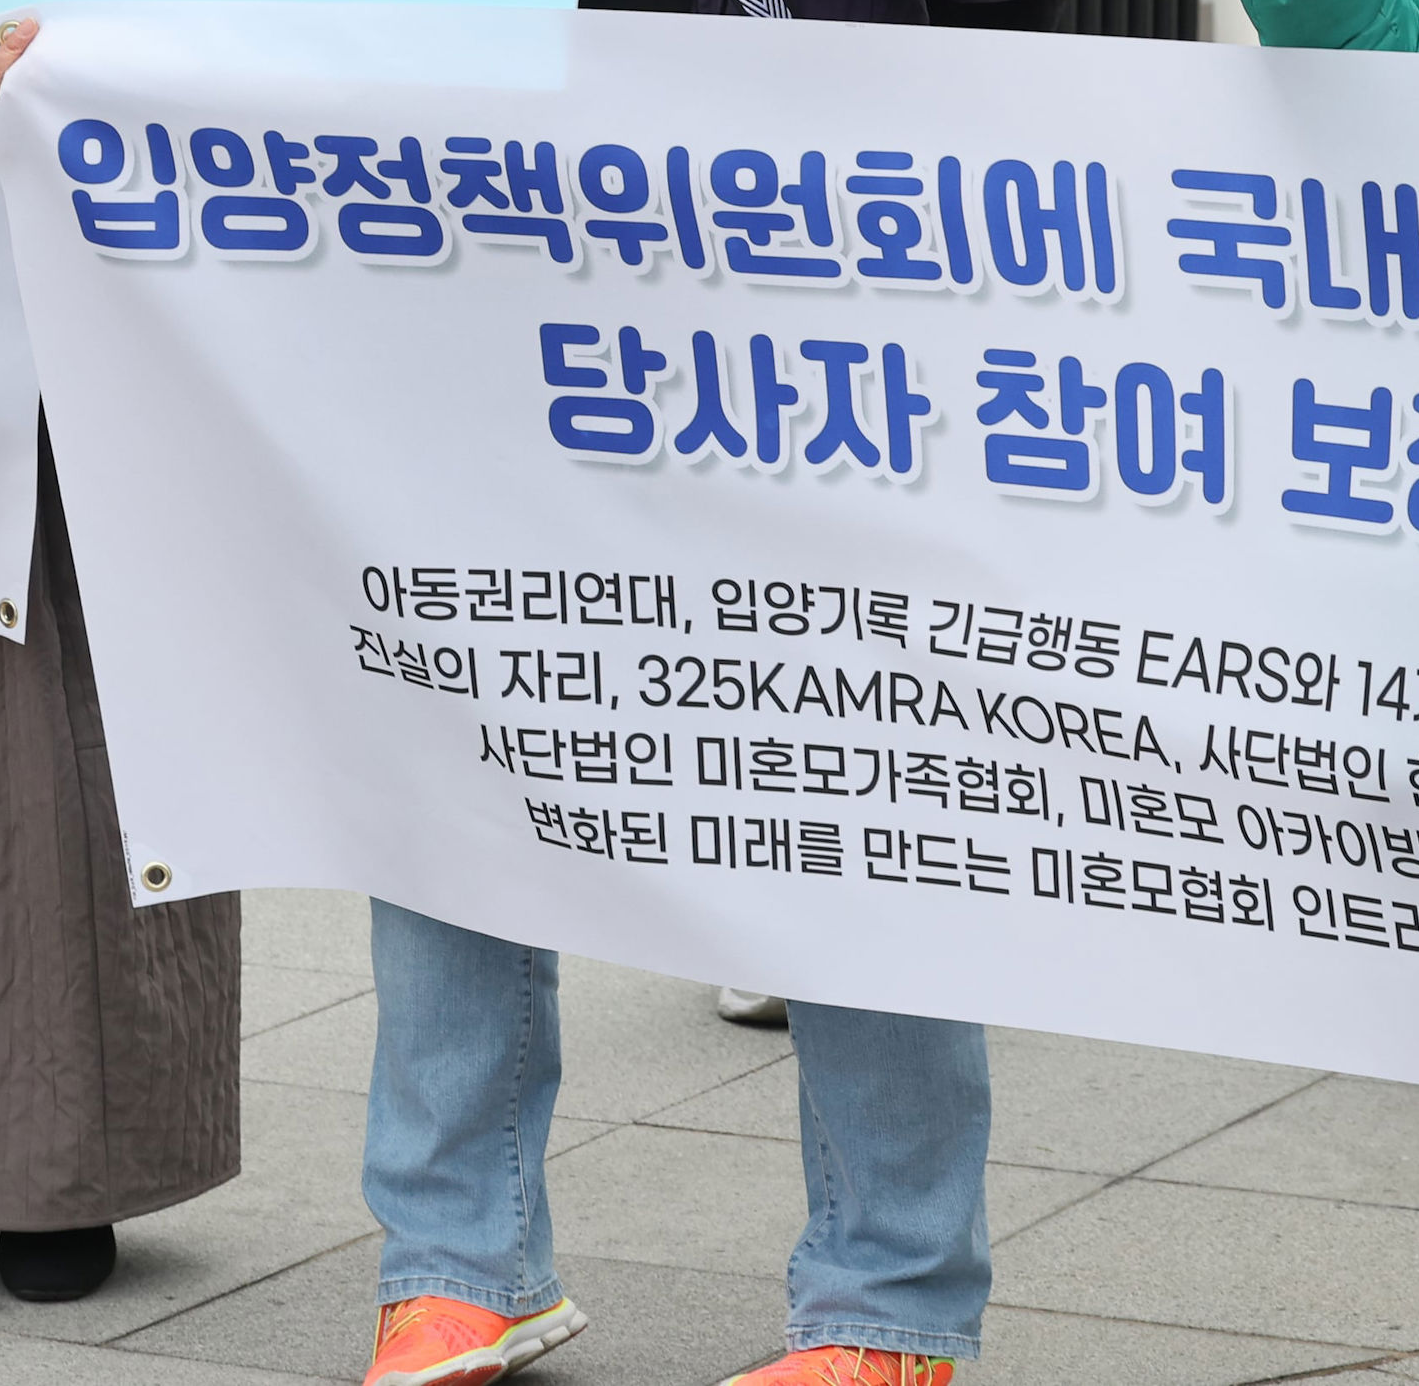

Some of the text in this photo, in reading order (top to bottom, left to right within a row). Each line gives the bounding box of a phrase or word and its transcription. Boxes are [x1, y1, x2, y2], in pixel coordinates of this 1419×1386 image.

[59, 120, 1115, 293] 입양정책위원회에
[541, 324, 930, 473] 당사자
[978, 349, 1224, 504] 참여
[350, 625, 478, 699] 진실의
[500, 650, 618, 710] 자리,
[639, 655, 969, 730] 325KAMRA
[983, 693, 1181, 774] KOREA,
[1200, 725, 1390, 803] 사단법인
[363, 567, 691, 634] 아동권리연대,
[712, 579, 908, 649] 입양기록
[930, 600, 1120, 678] 긴급행동
[1137, 631, 1339, 711] EARS와
[481, 724, 672, 786] 사단법인
[697, 737, 1063, 827] 미혼모가족협회,
[1082, 777, 1224, 844] 미혼모
[525, 798, 668, 864] 변화된
[691, 816, 843, 876] 미래를
[864, 828, 1010, 894] 만드는
[1032, 848, 1274, 931] 미혼모협회
